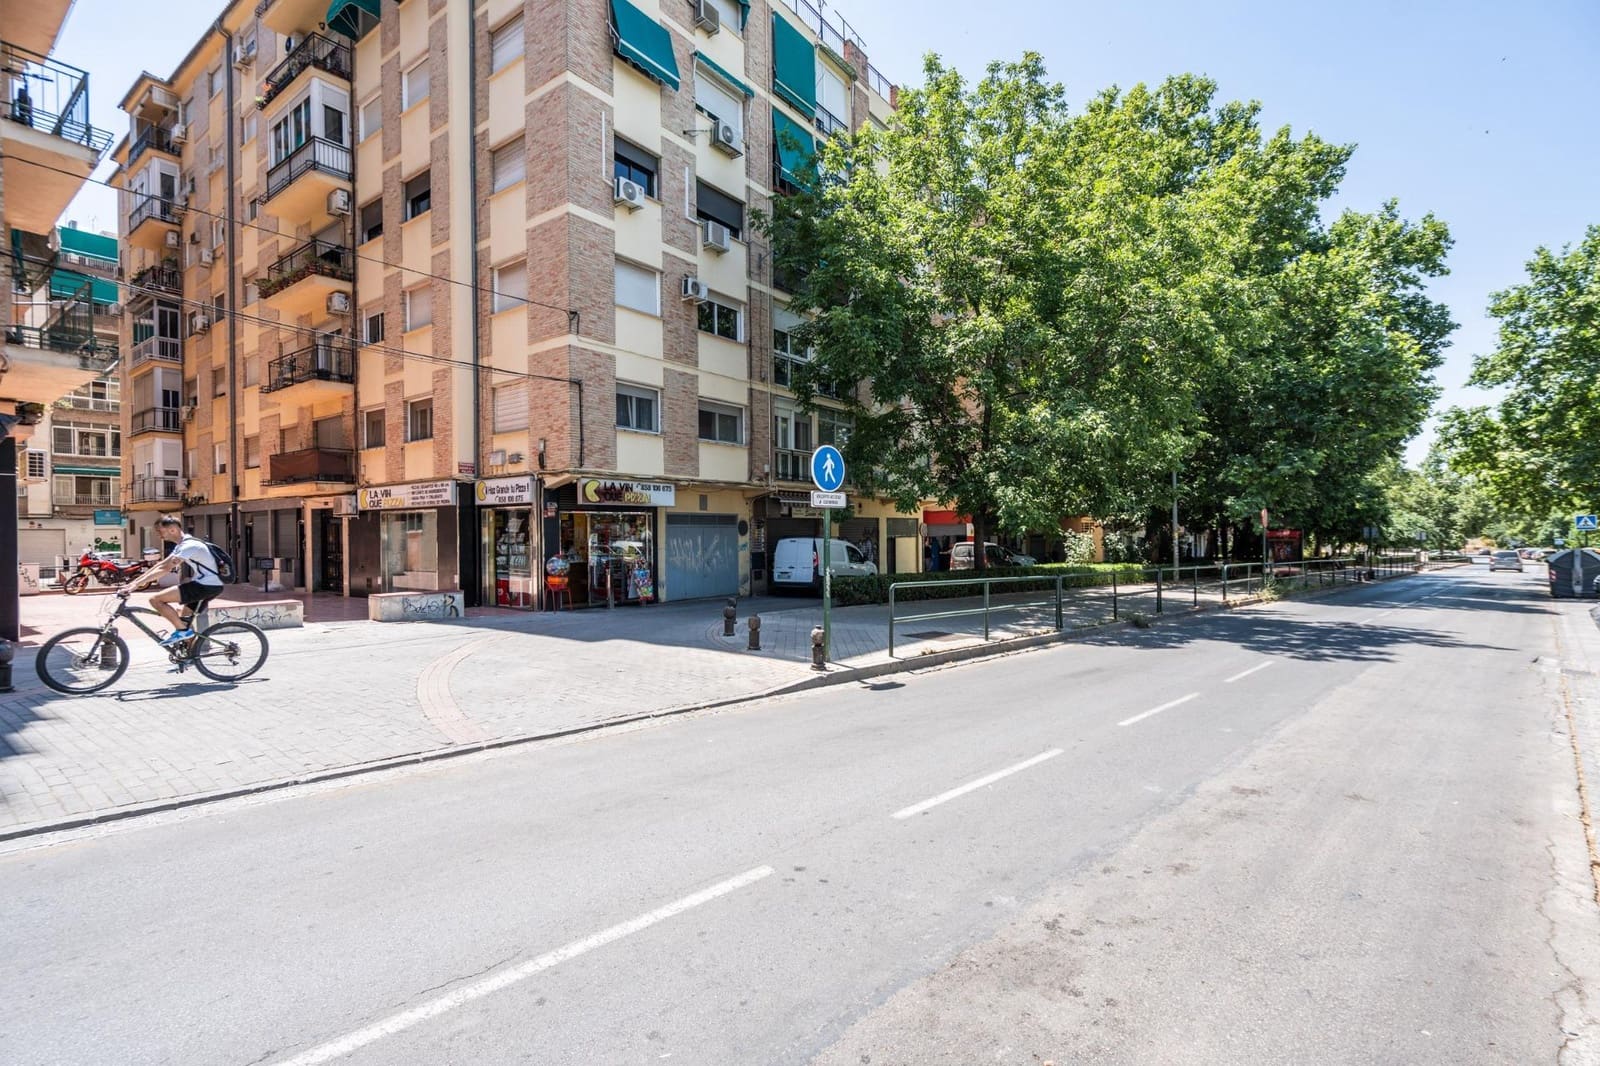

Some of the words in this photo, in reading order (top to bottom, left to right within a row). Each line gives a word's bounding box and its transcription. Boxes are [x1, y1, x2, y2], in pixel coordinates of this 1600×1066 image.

[604, 482, 616, 492] LA
[619, 482, 633, 492] VIN
[369, 490, 379, 499] LA
[380, 489, 391, 498] VIN
[369, 499, 382, 508] QUE
